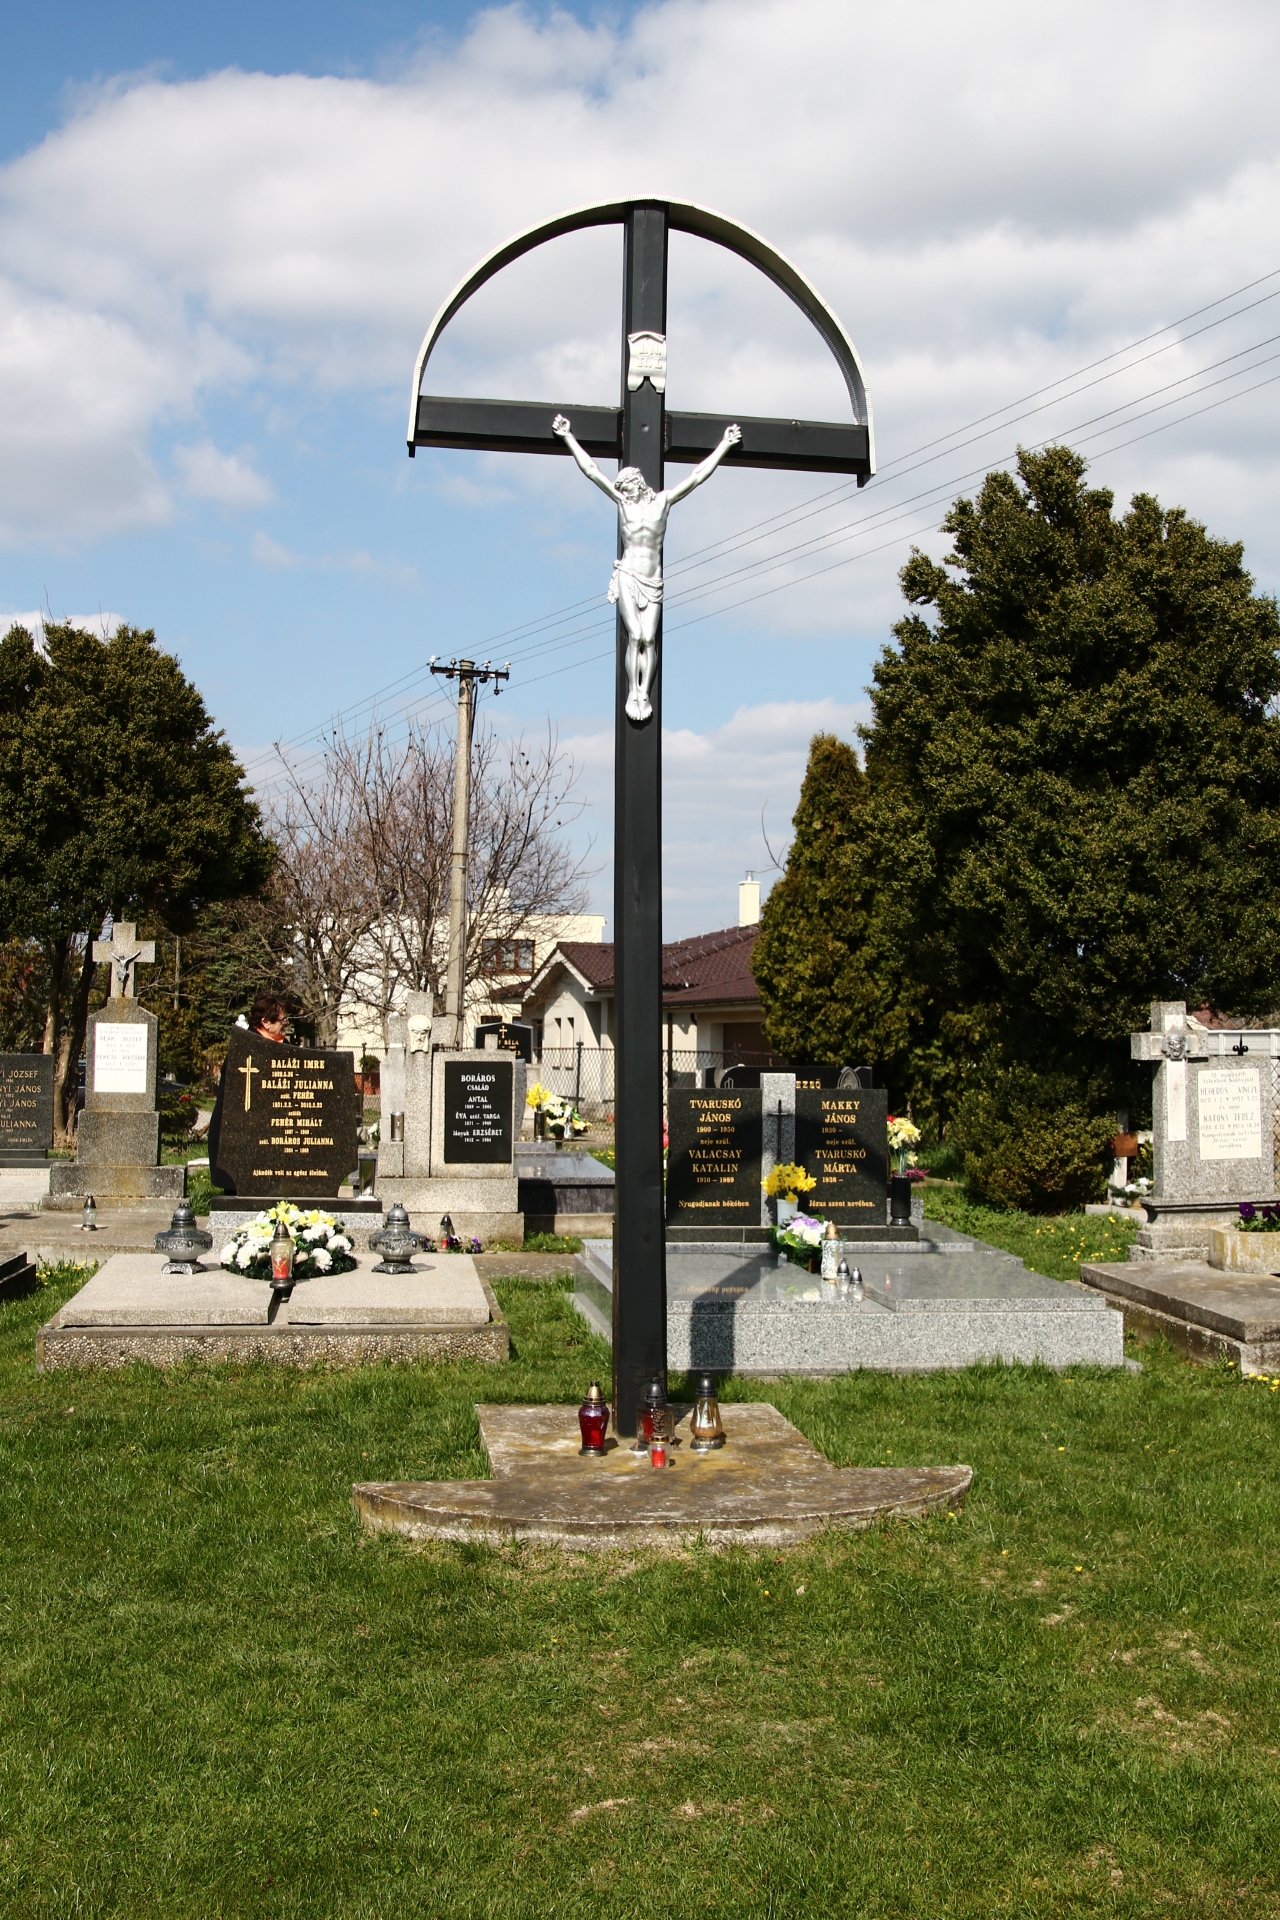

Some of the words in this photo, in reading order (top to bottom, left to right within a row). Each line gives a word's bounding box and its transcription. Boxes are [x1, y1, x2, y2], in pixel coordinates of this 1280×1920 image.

[304, 1060, 325, 1069] IMRE
[9, 1069, 38, 1078] JÓZSEF
[461, 1072, 496, 1082] BORÁROS
[15, 1084, 41, 1093] JÁNOS
[294, 1080, 334, 1089] JULIANNA
[466, 1083, 490, 1091] CSALÁD
[293, 1090, 315, 1099] FEHÉR
[10, 1098, 37, 1108] JÁNOS
[690, 1098, 742, 1109] TVARUSKÓ
[821, 1100, 860, 1110] MAKKY
[455, 1111, 467, 1120] ÉVA
[700, 1111, 731, 1122] JÁNOS
[825, 1112, 856, 1123] JÁNOS
[271, 1117, 294, 1127] FEHÉR
[296, 1117, 323, 1127] MIHÁLY
[472, 1128, 503, 1136] ERZSÉBET
[271, 1135, 301, 1145] BORÁROS
[303, 1137, 334, 1146] JULIANNA
[826, 1138, 840, 1146] neje
[688, 1149, 742, 1159] VALACSAY
[815, 1148, 866, 1159] TVARUSKÓ
[692, 1163, 739, 1172] KATALIN
[823, 1161, 857, 1172] MÁRTA
[679, 1200, 720, 1208] Nyugodjanak
